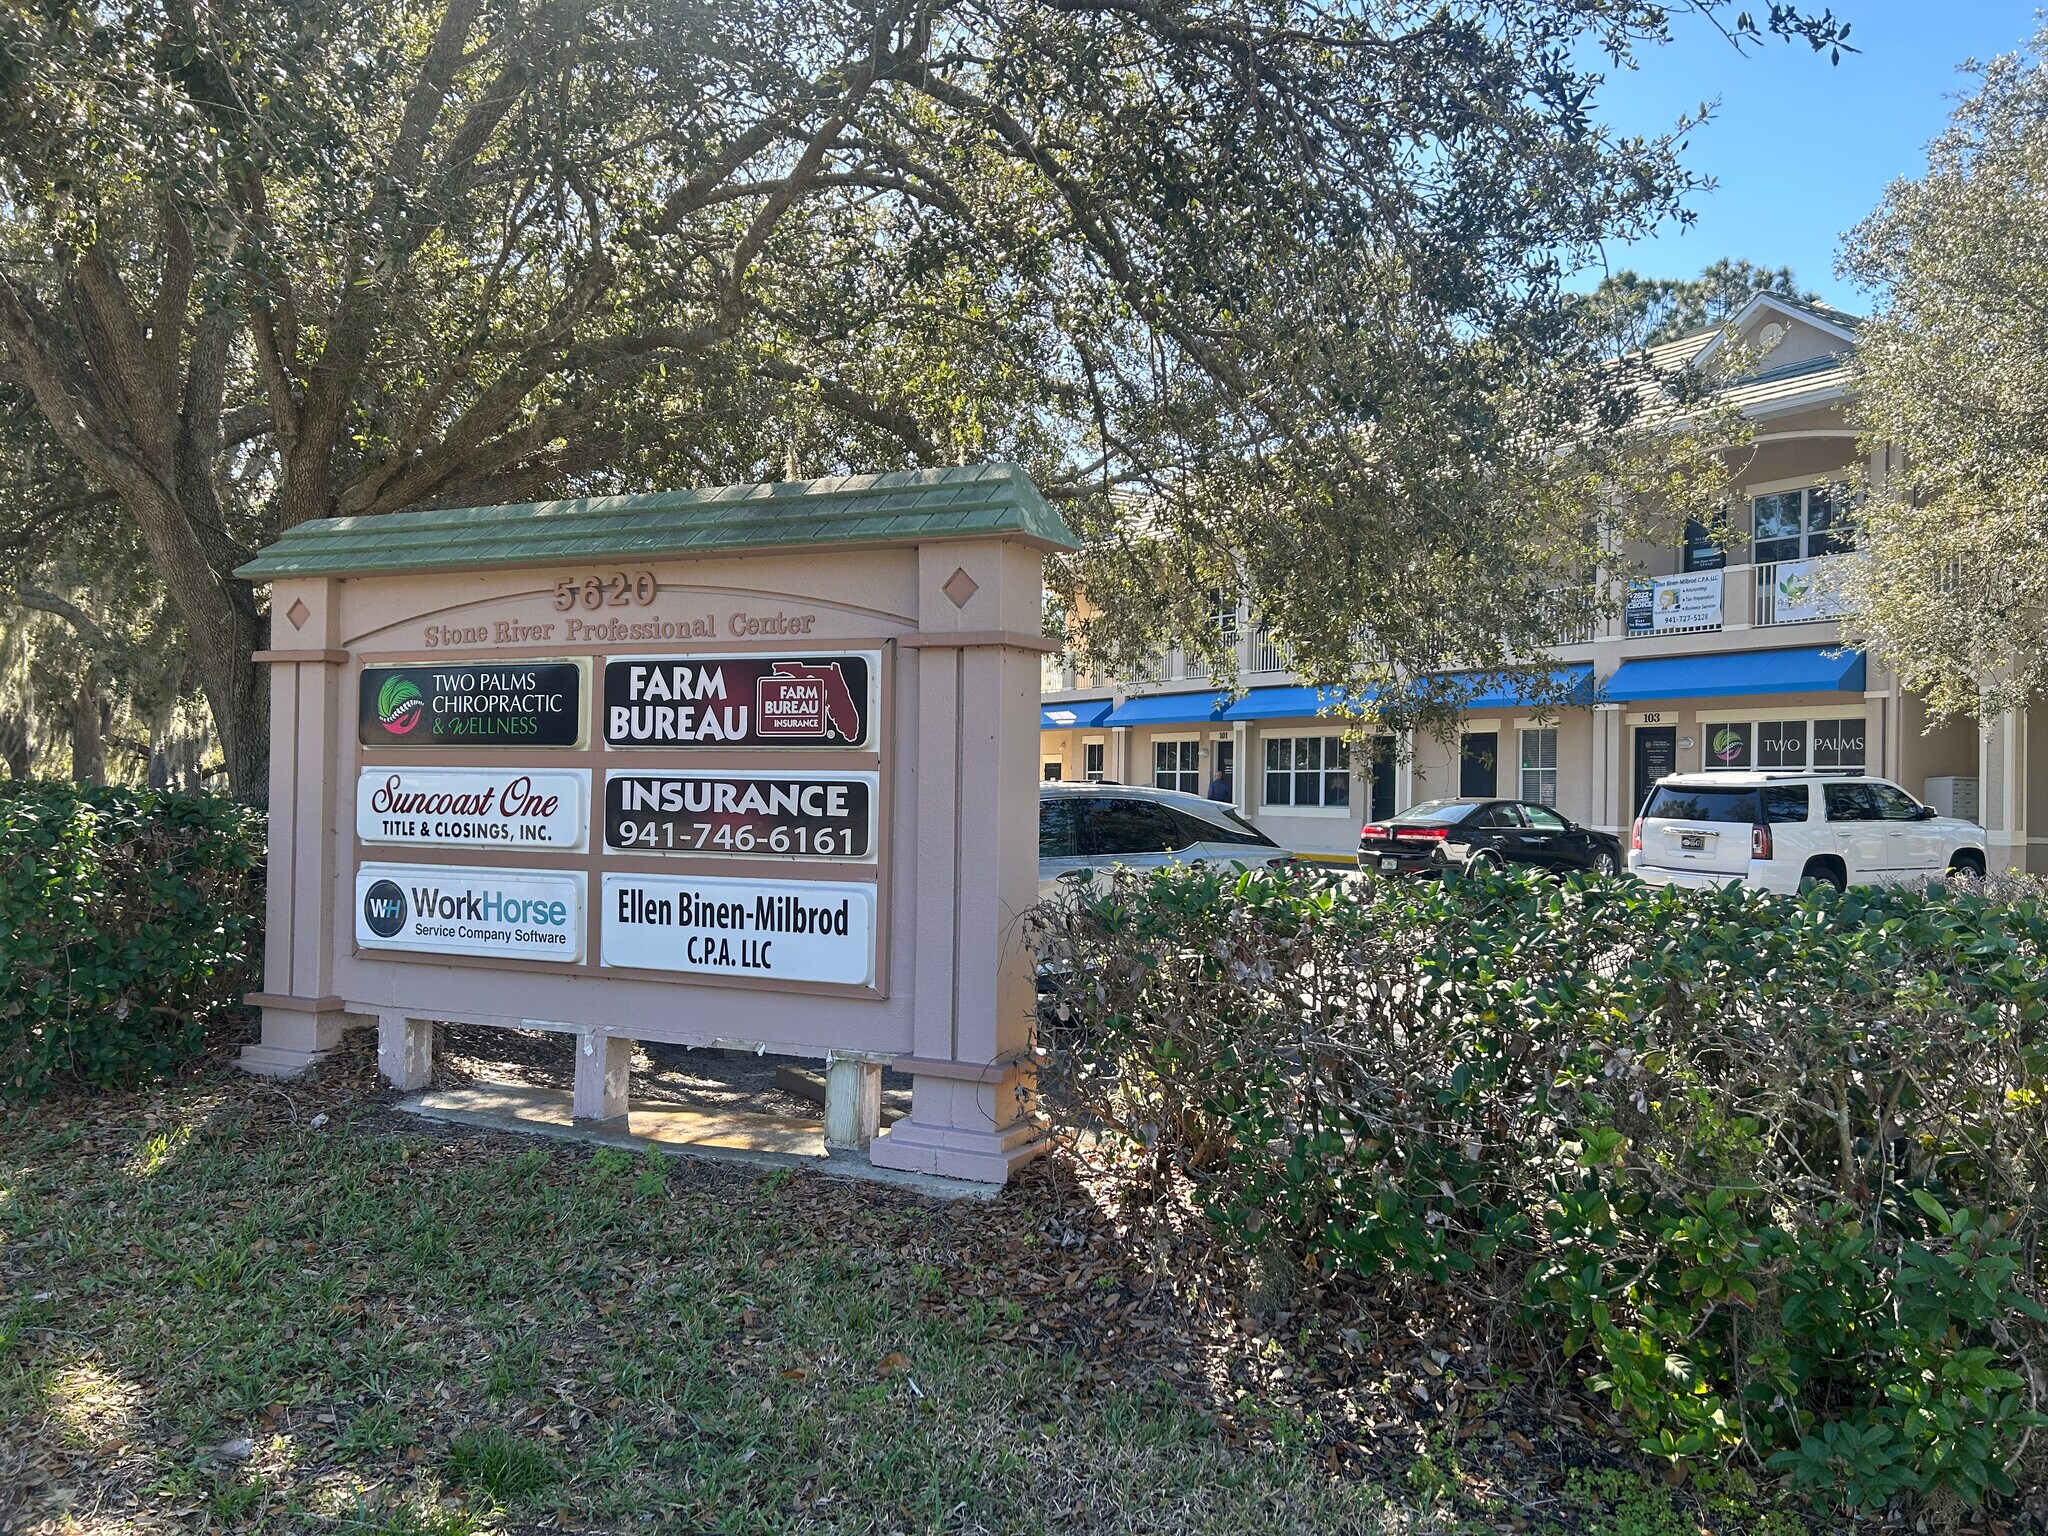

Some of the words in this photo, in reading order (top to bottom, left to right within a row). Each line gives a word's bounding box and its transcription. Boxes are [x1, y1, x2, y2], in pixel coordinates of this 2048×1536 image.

[553, 571, 657, 611] 5620
[1628, 601, 1653, 609] CHOICE
[425, 622, 488, 648] Stone
[493, 619, 554, 643] River
[565, 614, 716, 641] Professional
[728, 611, 815, 637] Center
[1664, 613, 1709, 624] 941-727-5128
[432, 674, 475, 692] TWO
[480, 672, 536, 692] PALMS
[629, 665, 728, 702] FARM
[780, 685, 818, 700] FARM
[432, 694, 563, 713] CHIROPRACTIC
[764, 700, 819, 714] BUREAU
[432, 717, 444, 735] &
[448, 716, 538, 735] WELLNESS
[609, 704, 748, 741] BUREAU
[773, 719, 819, 728] INSURANCE
[1643, 712, 1661, 723] 103
[1219, 731, 1228, 739] 101
[1763, 738, 1800, 752] TWO
[1813, 737, 1864, 751] PALMS
[371, 774, 495, 815] Suncoast
[499, 776, 559, 817] One
[621, 780, 850, 818] INSURANCE
[382, 820, 415, 837] TITLE
[420, 821, 431, 837] &
[435, 823, 514, 843] CLOSINGS,
[519, 825, 552, 841] INC.
[619, 820, 852, 855] 941-746-6161
[411, 887, 567, 926] WorkHorse
[618, 888, 672, 926] Ellen
[678, 891, 849, 936] Binen-Milbrod
[415, 923, 456, 938] Service
[458, 925, 512, 944] Company
[514, 929, 567, 945] Software
[687, 936, 736, 967] C.P.A.
[741, 939, 772, 969] LLC
